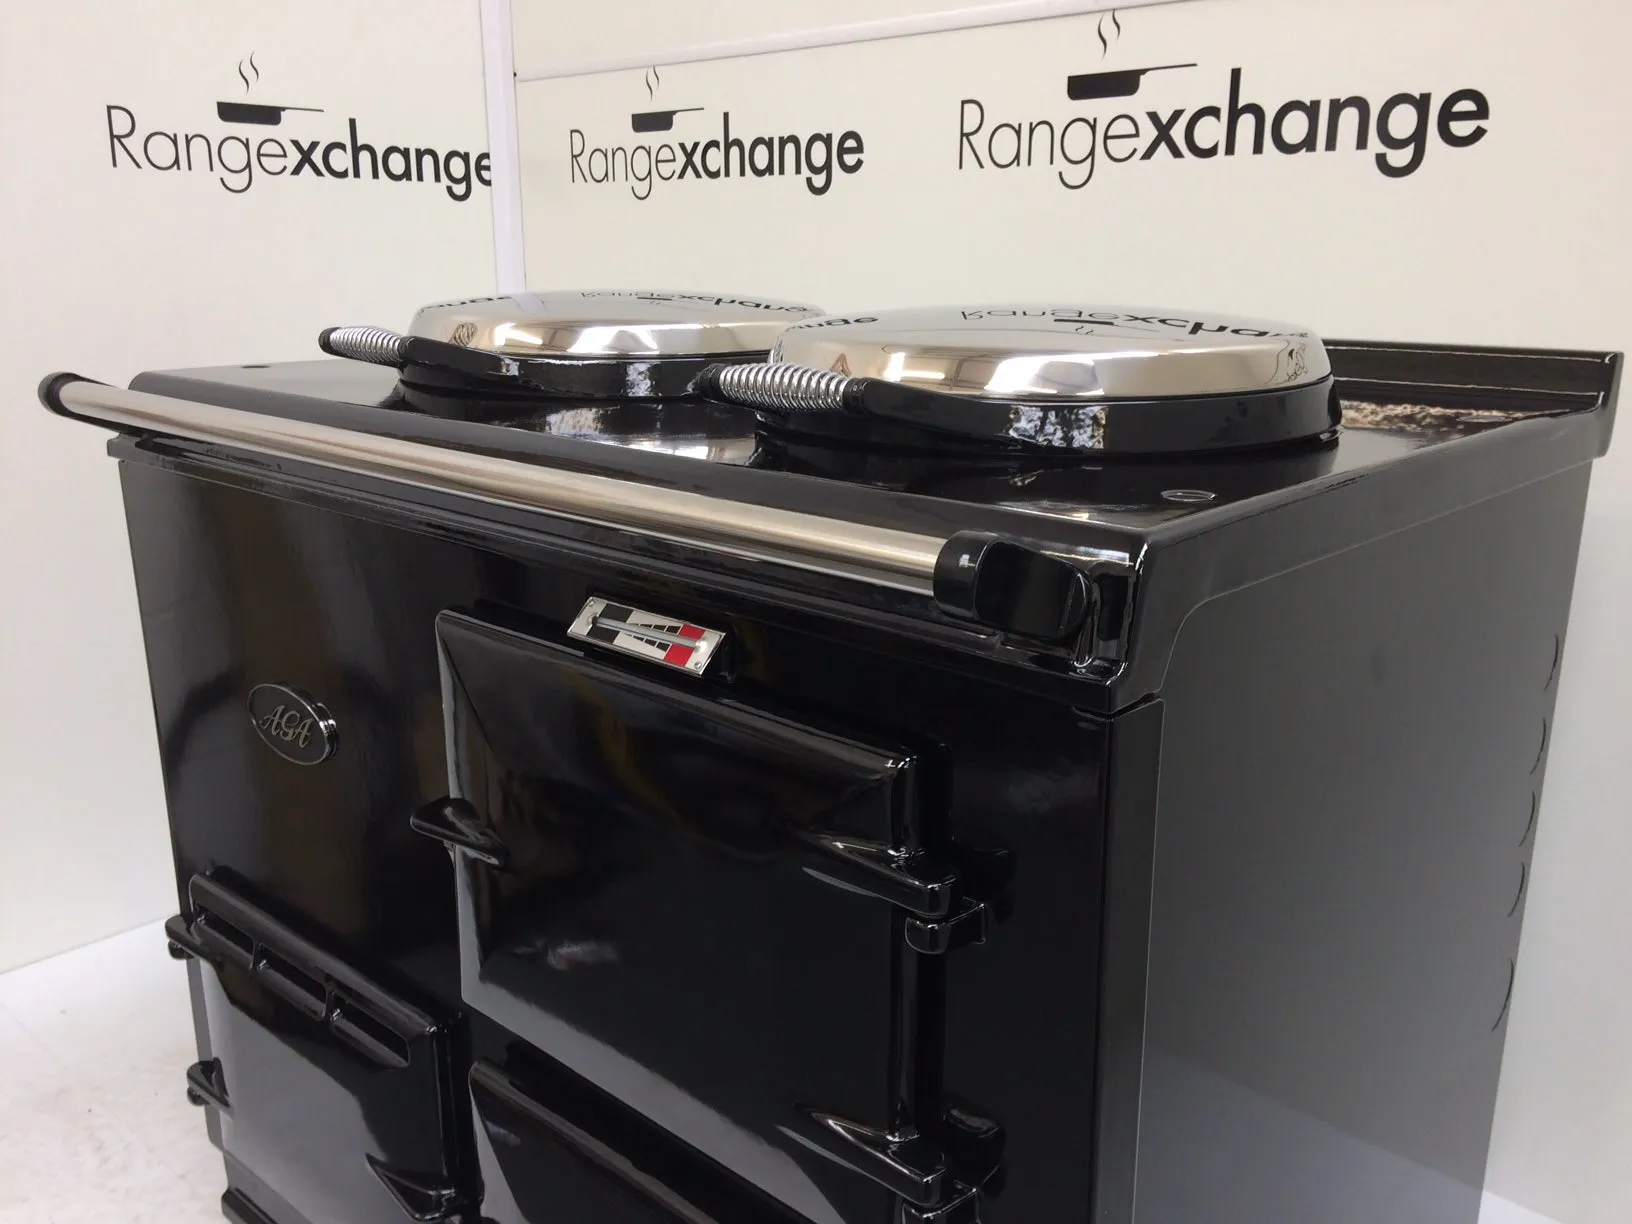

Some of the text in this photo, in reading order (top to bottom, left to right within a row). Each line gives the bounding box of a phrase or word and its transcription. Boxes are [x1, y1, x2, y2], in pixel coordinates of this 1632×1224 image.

[106, 104, 492, 202] Rangexchange
[569, 111, 865, 201] Rangexchange
[958, 67, 1490, 190] Rangexchange
[259, 704, 315, 749] AGA
